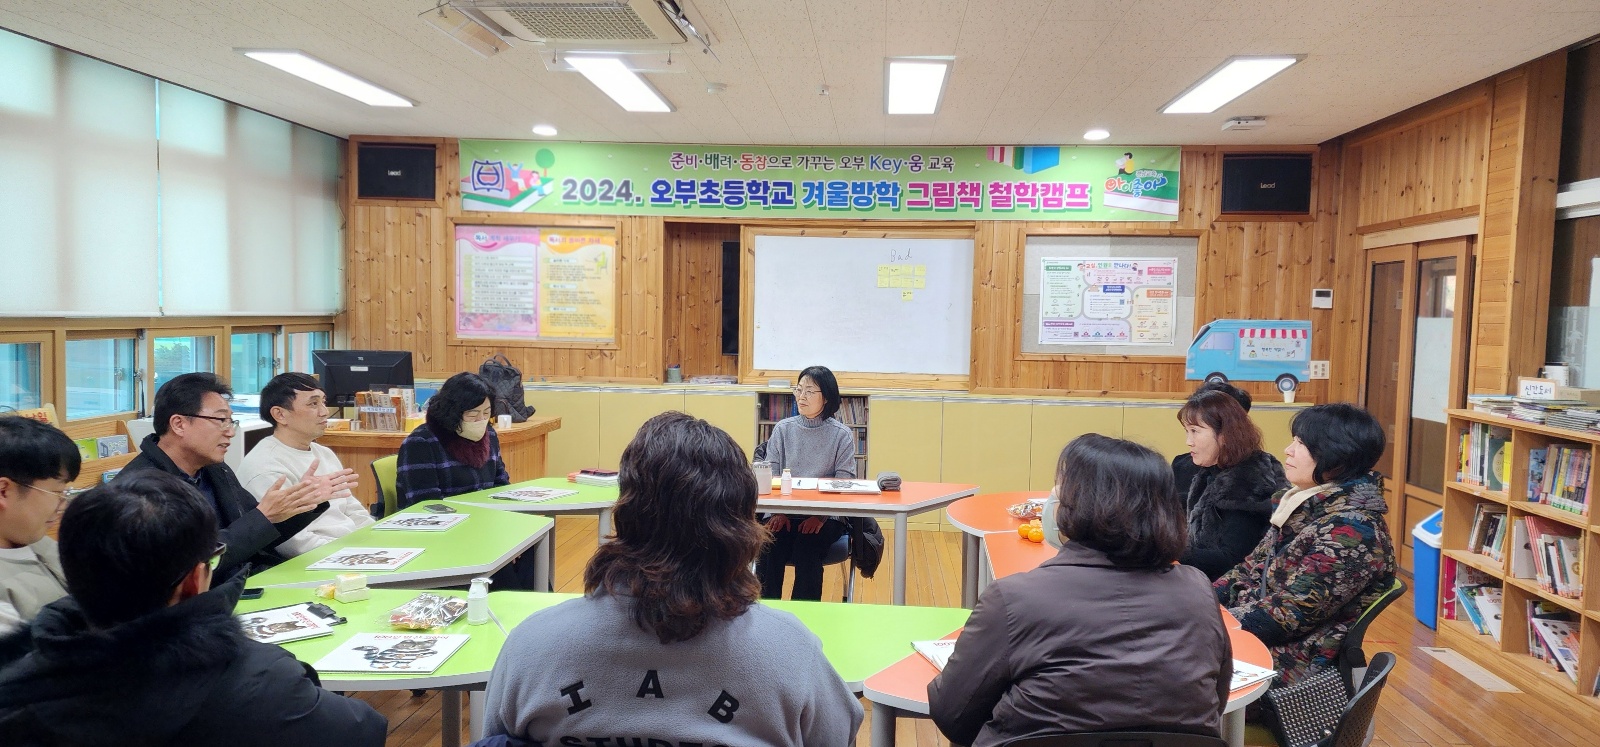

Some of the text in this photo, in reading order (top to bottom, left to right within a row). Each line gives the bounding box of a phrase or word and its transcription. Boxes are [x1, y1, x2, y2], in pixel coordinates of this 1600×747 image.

[670, 152, 955, 174] 준비·배려·동참으로 가꾸는 오부 Key·움 교육
[562, 178, 1091, 208] 2024. 오부초등학교 겨울방학 그림책 철학캠프
[1104, 176, 1168, 198] 아이좋아
[890, 247, 913, 263] Bad
[1524, 385, 1552, 396] 신간도서
